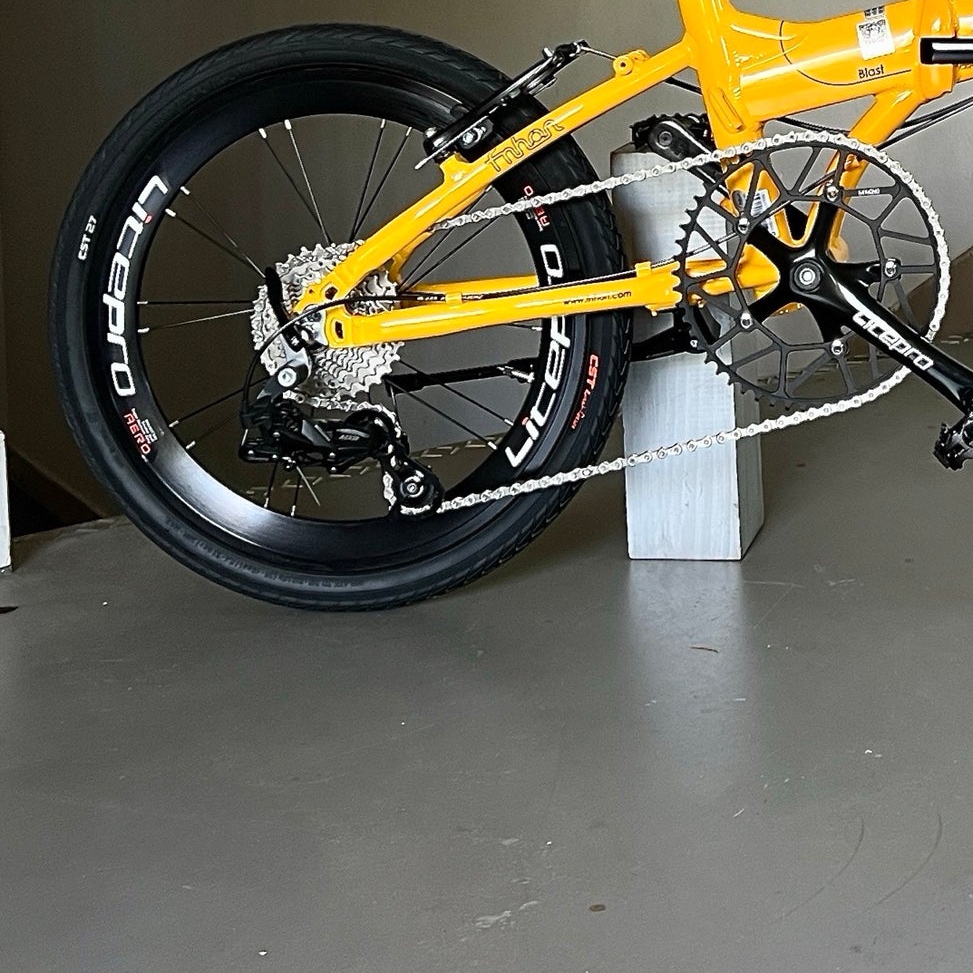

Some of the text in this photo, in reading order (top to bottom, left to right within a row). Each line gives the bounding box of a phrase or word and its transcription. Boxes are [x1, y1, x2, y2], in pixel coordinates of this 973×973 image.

[858, 64, 885, 79] Blast
[485, 118, 565, 173] fnhon
[524, 185, 551, 227] AEO
[78, 214, 97, 261] CST 27
[586, 353, 600, 388] CST
[123, 413, 152, 455] AERO
